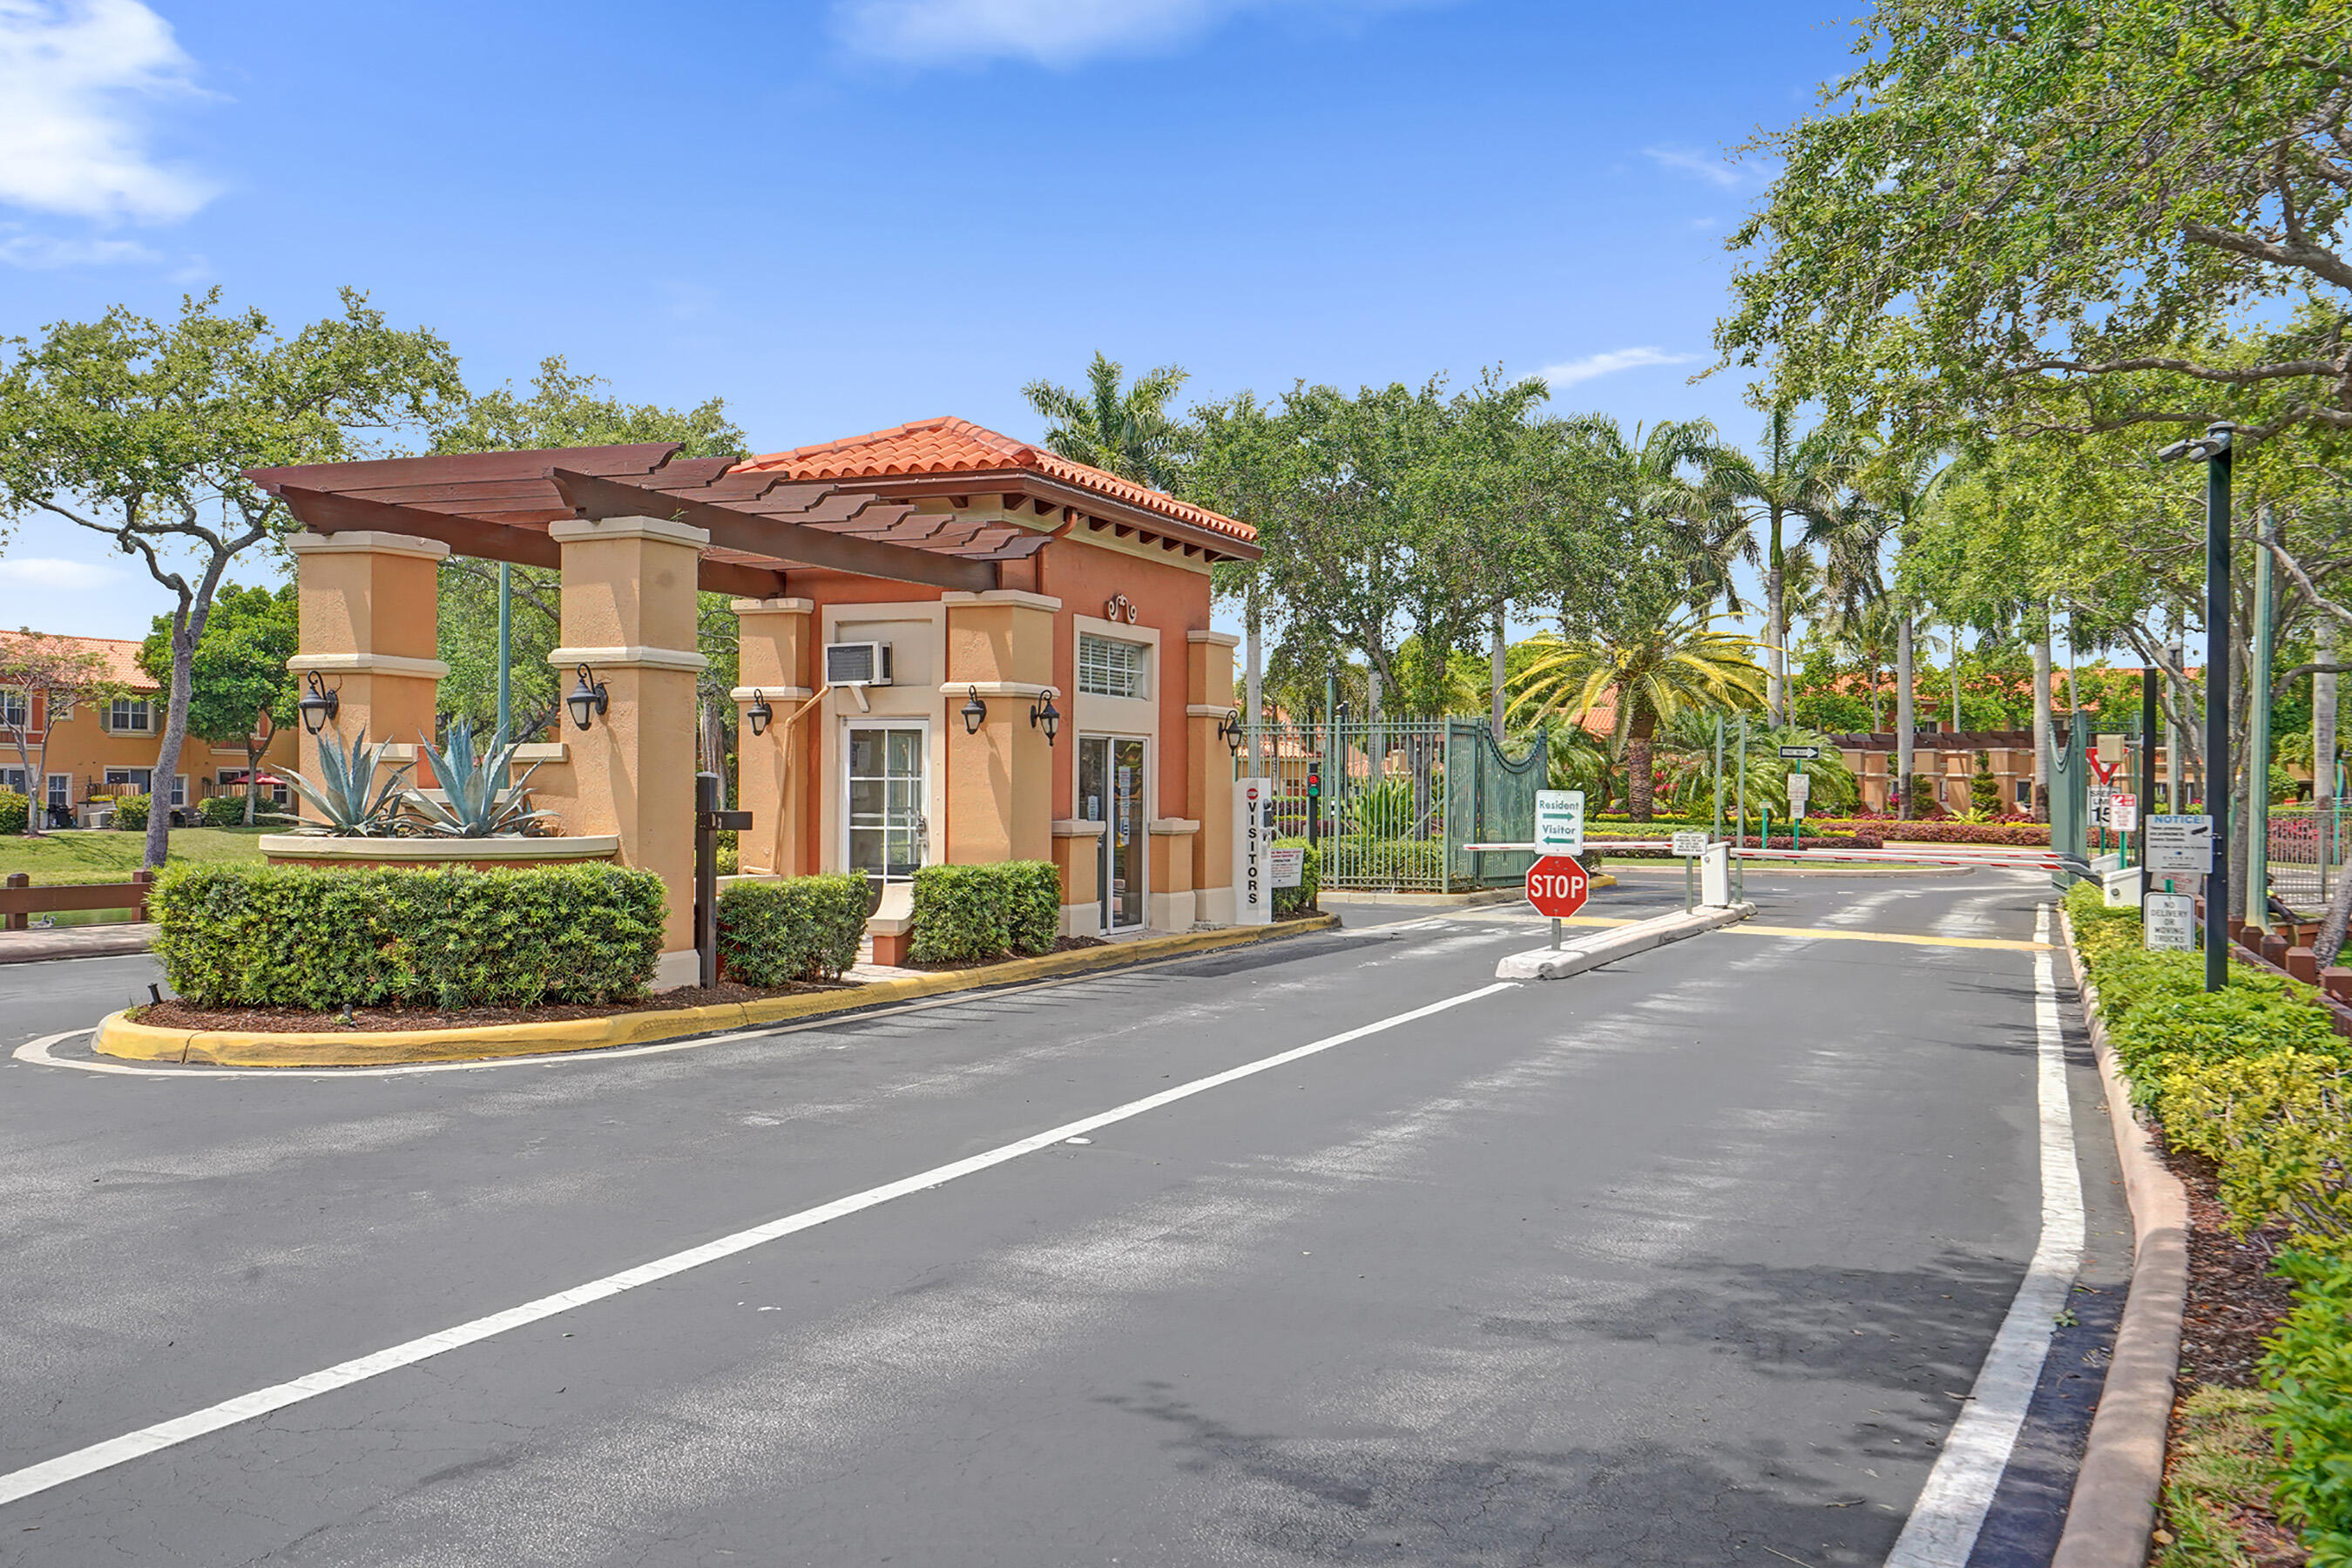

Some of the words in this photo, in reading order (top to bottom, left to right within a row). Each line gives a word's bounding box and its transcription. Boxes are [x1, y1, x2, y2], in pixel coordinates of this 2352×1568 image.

[1539, 800, 1579, 810] Resident
[2154, 815, 2205, 824] NOTICE!
[1542, 824, 1576, 835] Visitor
[1247, 801, 1258, 904] VISITORS
[1530, 874, 1585, 899] STOP
[2150, 909, 2188, 917] DELIVERY
[2154, 926, 2186, 935] MOVING
[2154, 935, 2186, 943] TRUCKS
